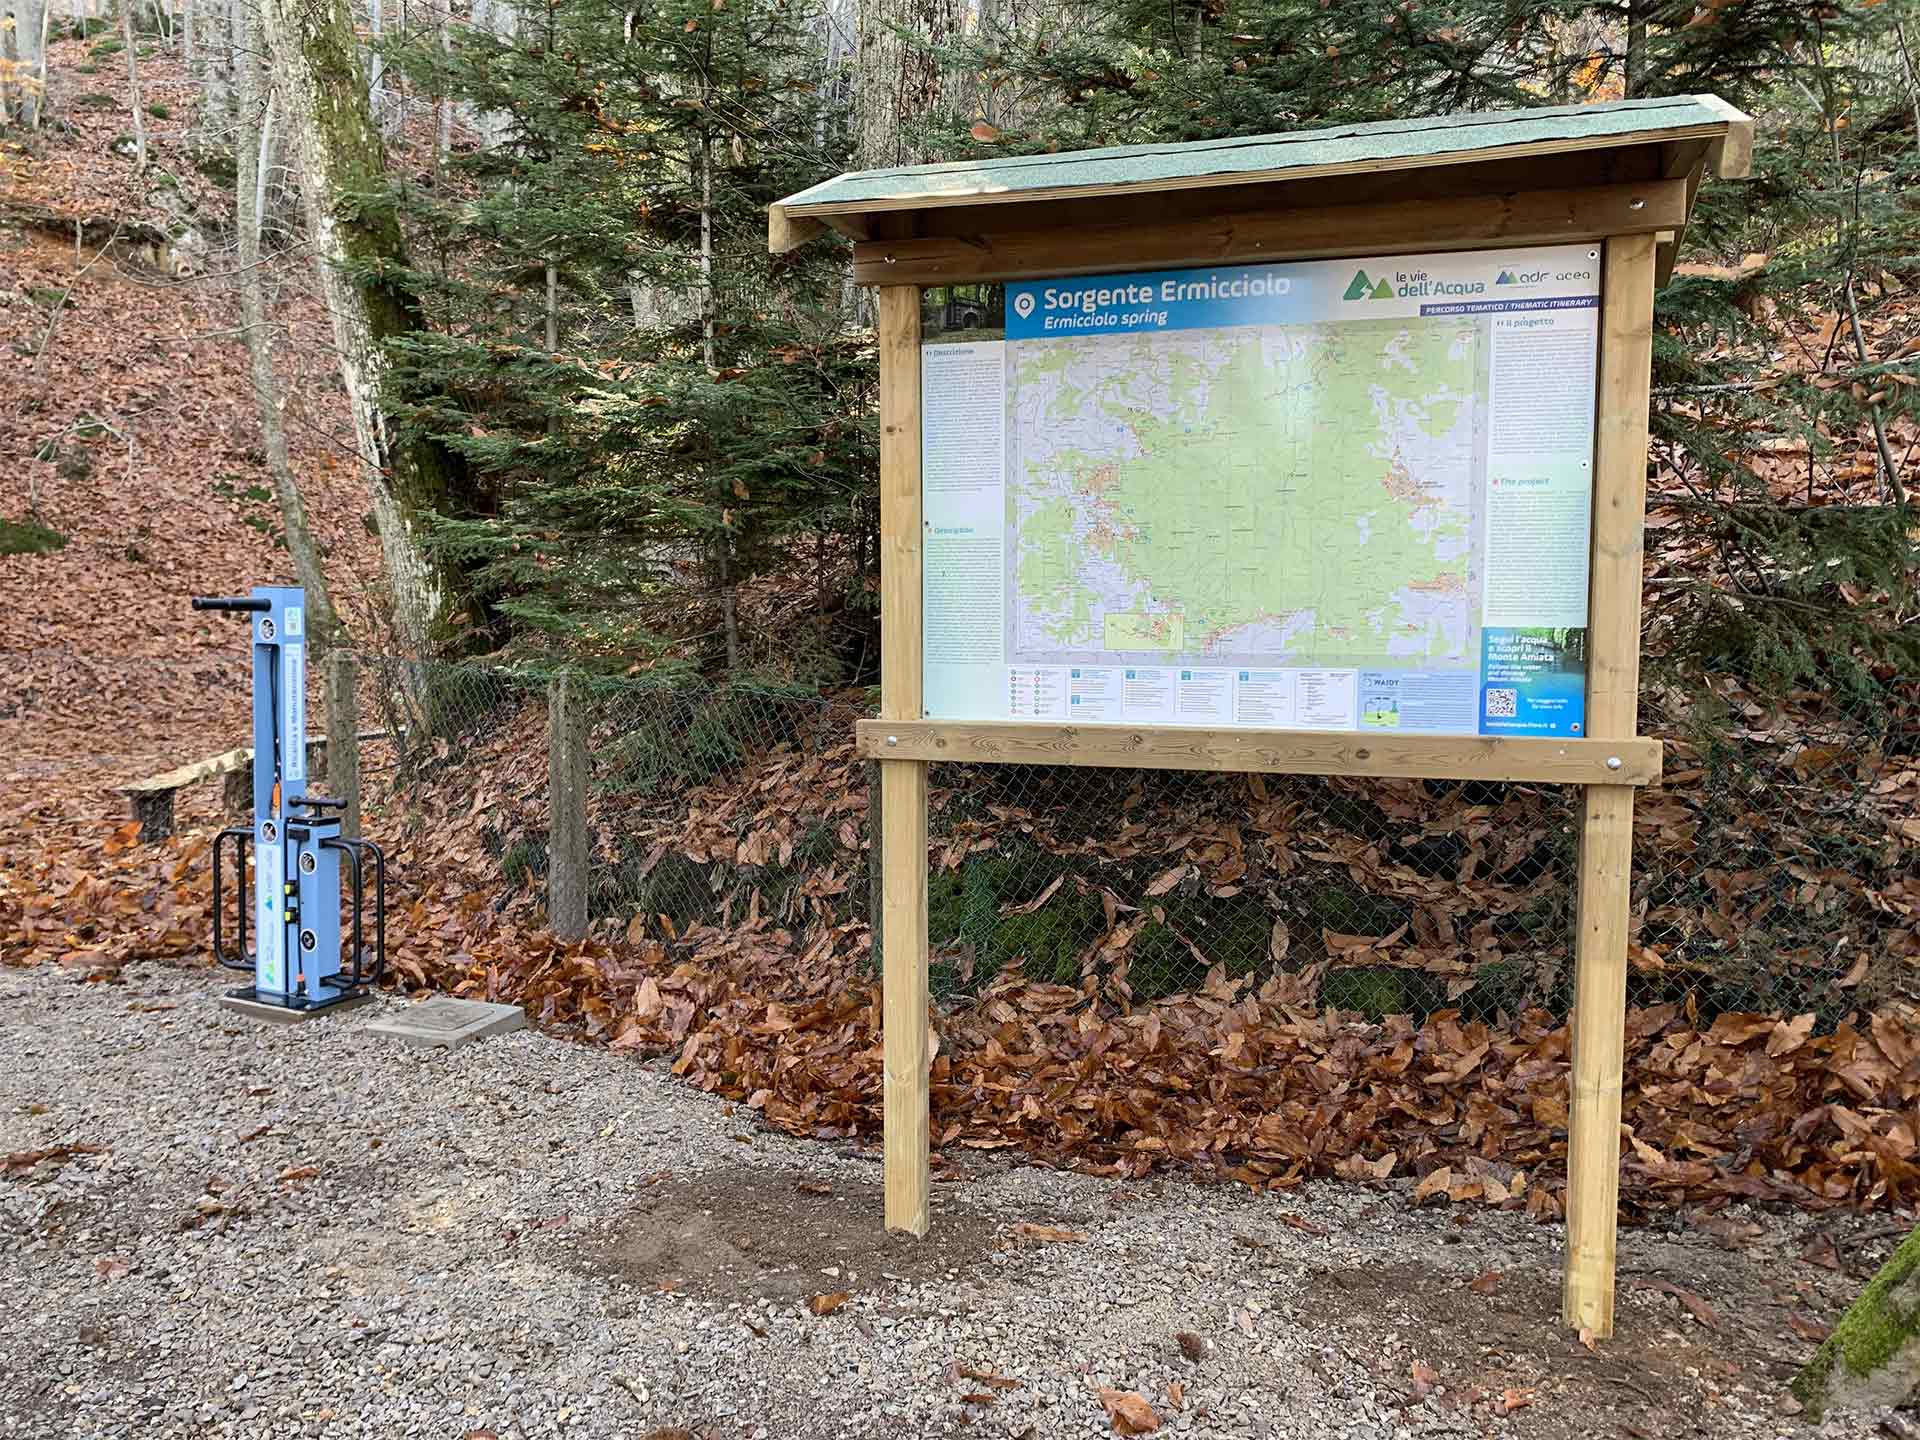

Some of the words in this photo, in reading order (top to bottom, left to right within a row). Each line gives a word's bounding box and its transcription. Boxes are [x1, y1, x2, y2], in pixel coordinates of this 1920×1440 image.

[1396, 271, 1407, 282] le
[1410, 269, 1428, 281] vie
[1556, 271, 1591, 281] acea
[1044, 284, 1153, 312] Sorgente
[1161, 274, 1291, 302] Ermicciolo
[1398, 281, 1485, 298] dell'Acqua
[1426, 304, 1465, 314] PERCORSO
[1466, 302, 1504, 313] TEMATICO
[1511, 300, 1549, 310] THEMATIC
[1550, 298, 1593, 308] ITINERARY
[1045, 312, 1119, 330] Ermicciolo
[1121, 309, 1168, 328] spring
[1513, 316, 1554, 329] progetto
